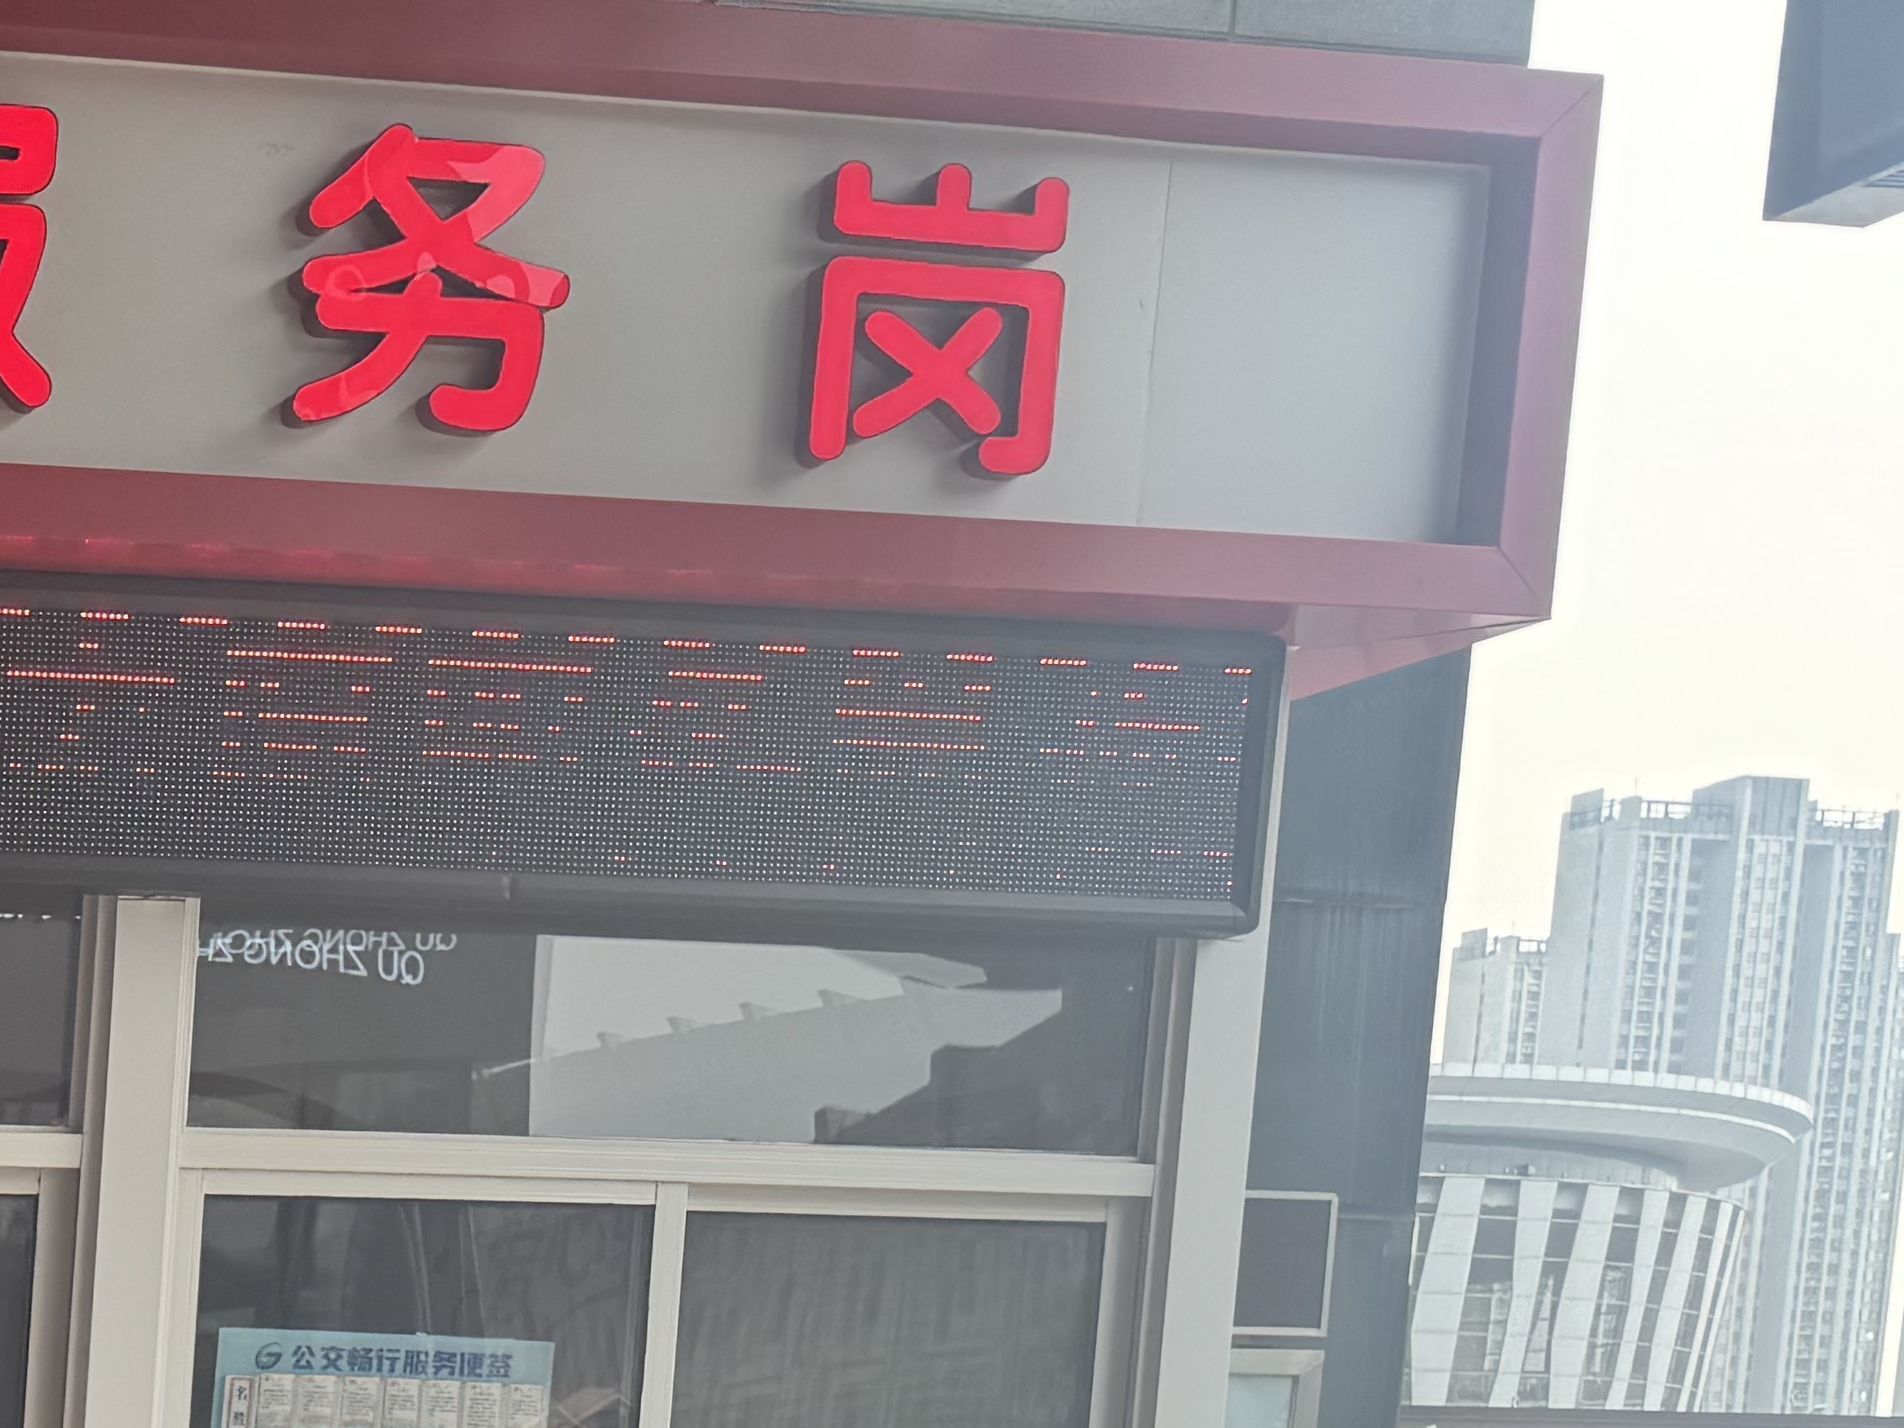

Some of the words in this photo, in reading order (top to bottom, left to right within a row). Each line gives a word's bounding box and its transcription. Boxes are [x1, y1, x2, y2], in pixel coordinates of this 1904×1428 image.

[292, 1344, 514, 1378] 公交畅行服务便签
